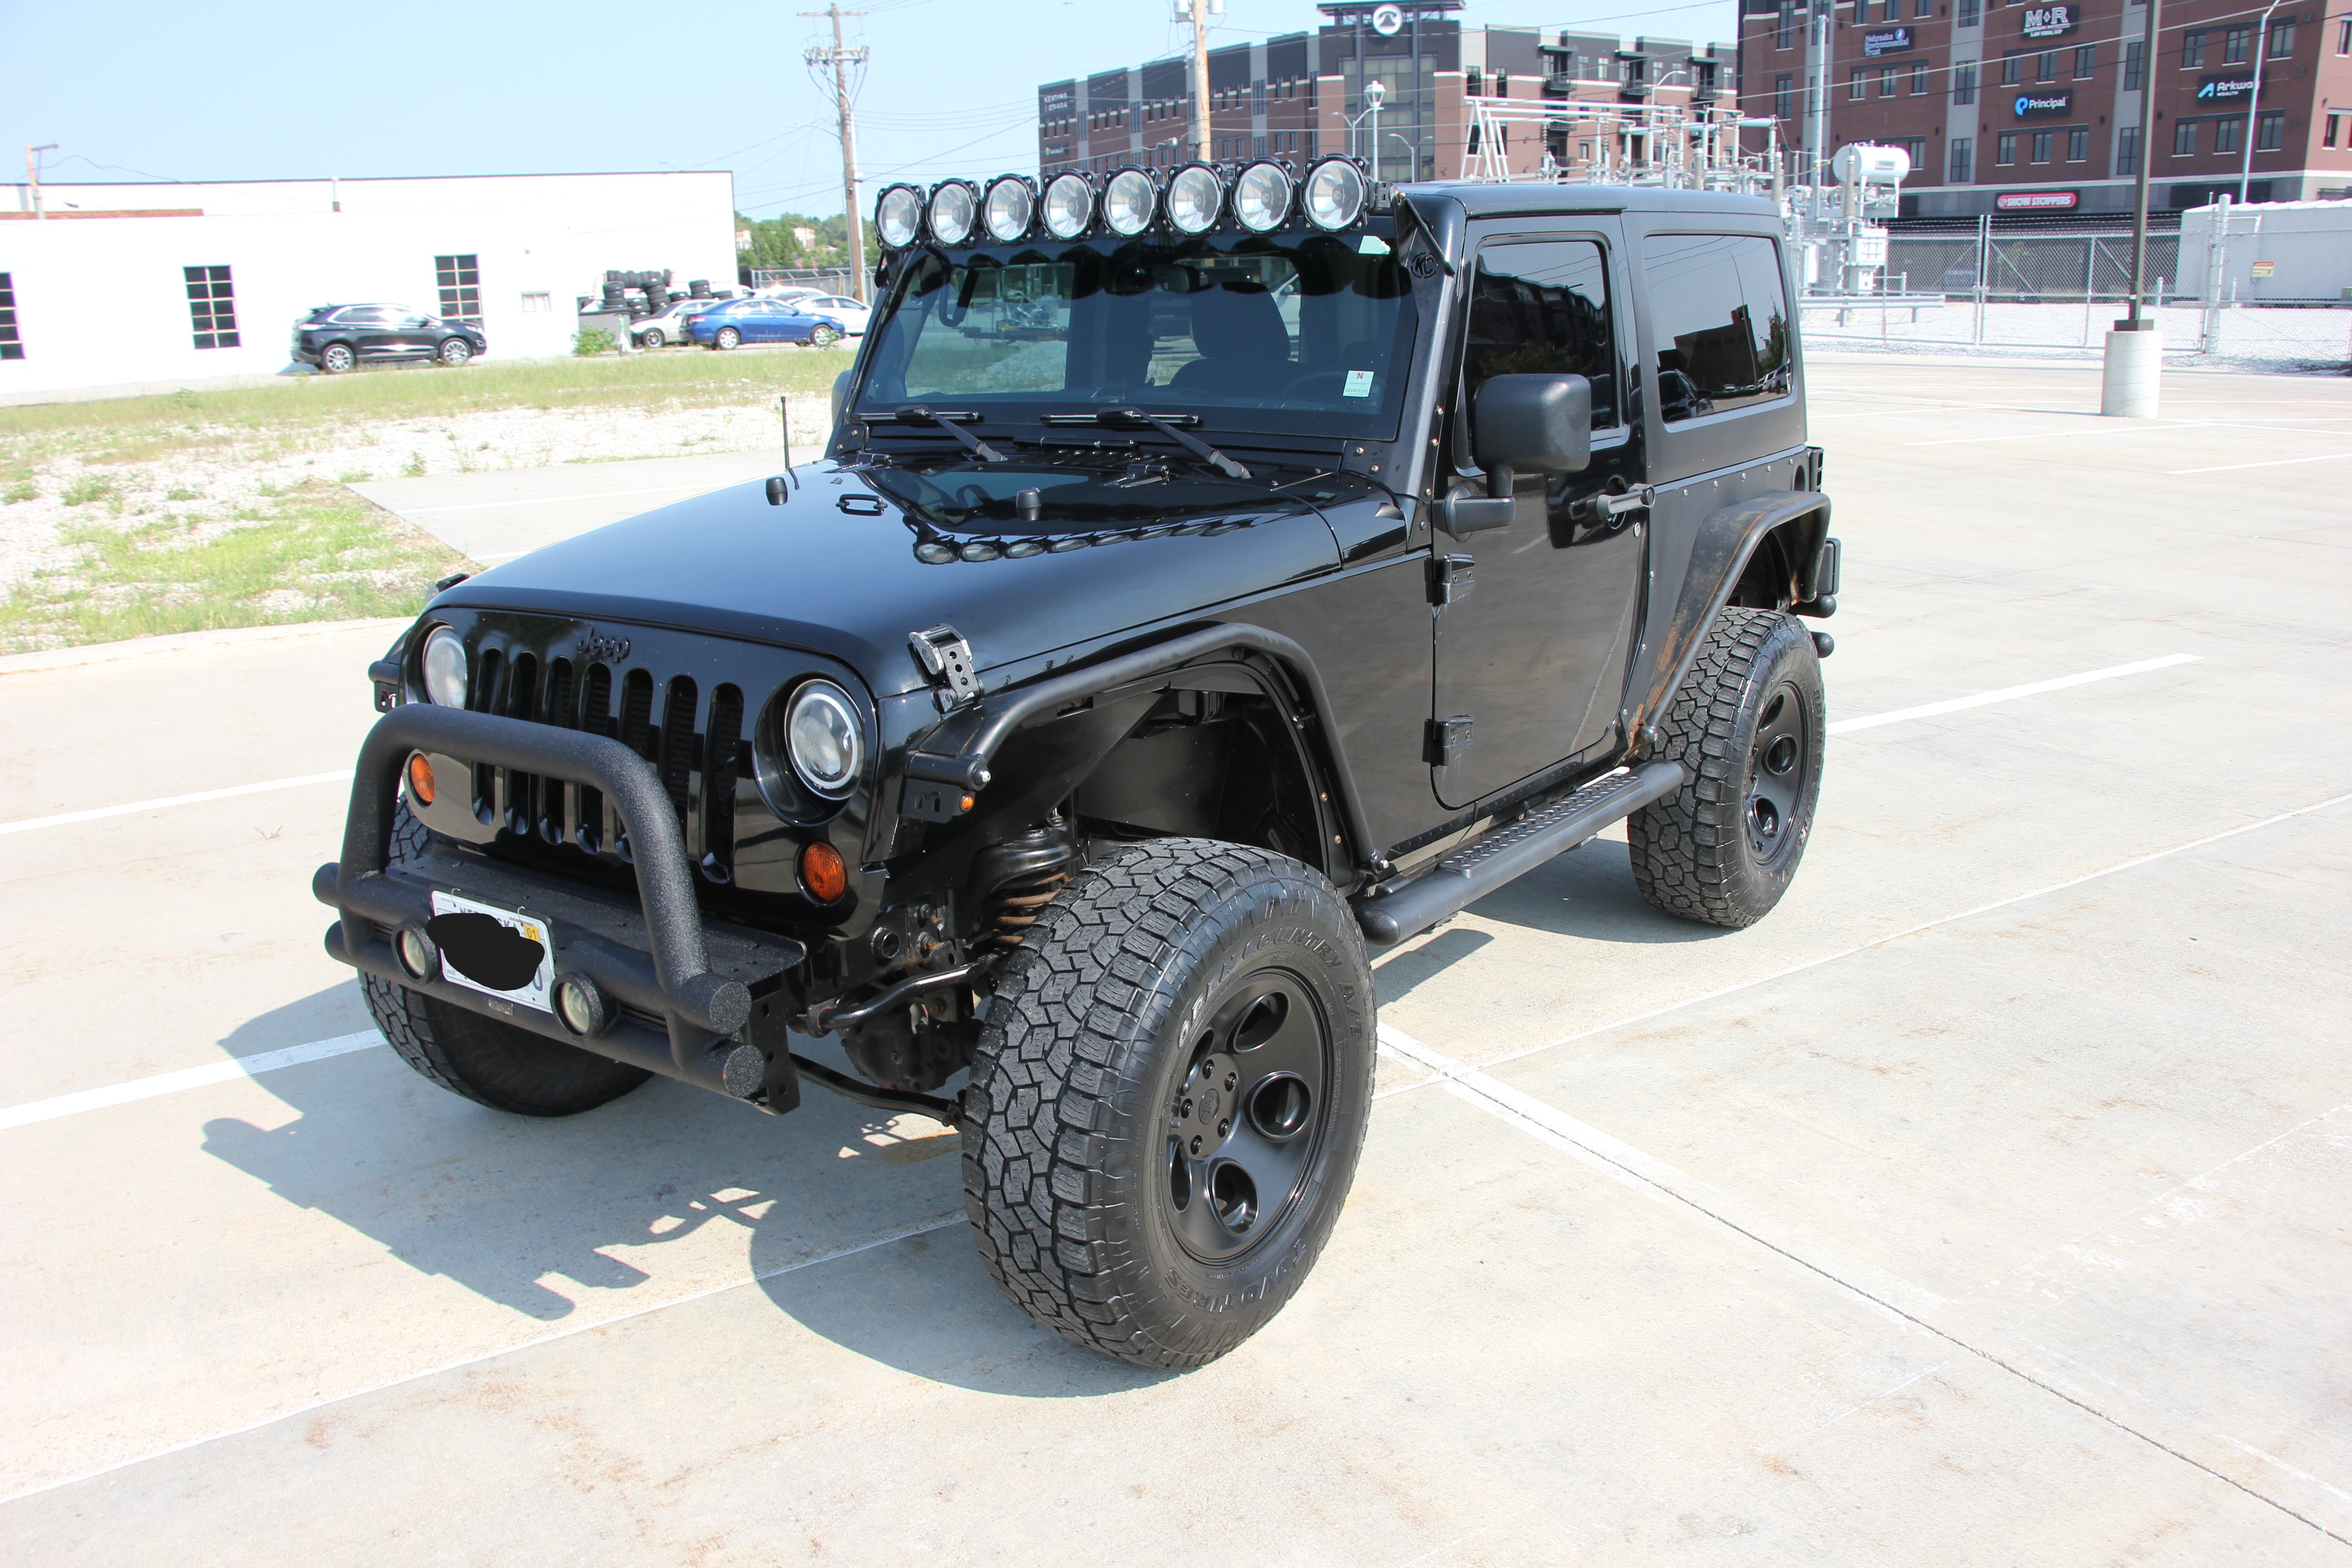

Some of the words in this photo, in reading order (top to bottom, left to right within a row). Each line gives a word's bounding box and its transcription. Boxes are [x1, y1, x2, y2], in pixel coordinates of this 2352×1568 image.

[2029, 97, 2066, 109] Principal
[2007, 197, 2031, 206] SHOW
[2031, 196, 2071, 206] STOPPERS
[576, 627, 630, 664] Jeep
[526, 927, 537, 940] 01
[1179, 951, 1240, 1049] OPEN
[1242, 926, 1347, 968] COUNTRY
[1164, 1265, 1239, 1313] TIRES
